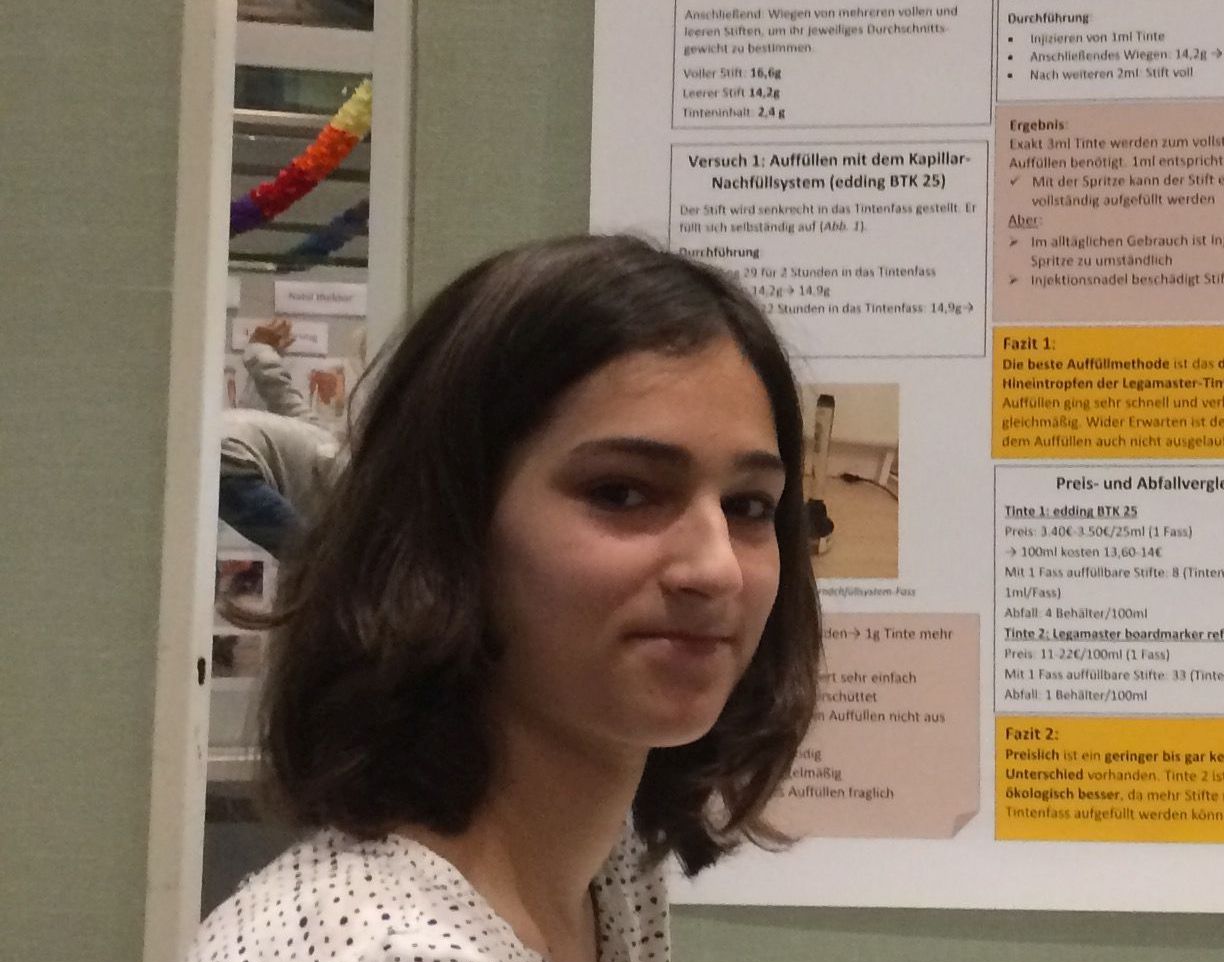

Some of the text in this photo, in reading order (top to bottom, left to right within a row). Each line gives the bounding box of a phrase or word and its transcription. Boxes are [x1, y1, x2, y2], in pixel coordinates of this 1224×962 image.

[683, 67, 716, 79] Voller
[682, 88, 717, 98] Leerer
[778, 108, 785, 118] g
[688, 153, 747, 168] Versuch
[842, 152, 866, 166] mit
[871, 152, 904, 166] dem
[909, 151, 970, 168] Kapillar-
[829, 174, 885, 191] (edding
[890, 174, 917, 187] BTK
[1032, 175, 1053, 188] Mit
[1057, 175, 1077, 187] der
[1082, 174, 1124, 188] Spritze
[1129, 174, 1159, 186] kann
[1163, 173, 1184, 186] der
[1188, 172, 1214, 185] Stift
[1031, 193, 1099, 208] vollständig
[1166, 192, 1215, 205] werden
[1007, 213, 1041, 229] Aber:
[1003, 336, 1038, 350] Fazit
[1002, 358, 1023, 370] Die
[1027, 357, 1063, 370] beste
[1173, 359, 1187, 369] ist
[1192, 357, 1214, 369] das
[1002, 376, 1093, 390] Hineintropfen
[1096, 376, 1118, 389] der
[1056, 476, 1098, 490] Preis-
[1103, 476, 1132, 490] und
[1005, 505, 1035, 519] Tinte
[1052, 505, 1094, 519] edding
[1097, 505, 1119, 518] BTK
[883, 627, 915, 639] Tinte
[919, 627, 952, 640] mehr
[1004, 627, 1035, 641] Tinte
[1053, 628, 1120, 642] Legamaster
[1125, 628, 1204, 642] boardmarker
[840, 671, 916, 684] sehr einfach
[1005, 726, 1040, 741] Fazit
[1005, 748, 1059, 760] Preislich
[1063, 750, 1076, 760] ist
[1081, 752, 1100, 760] ein
[1104, 749, 1158, 764] geringer
[1162, 750, 1180, 762] bis
[1184, 753, 1206, 765] gar
[1005, 767, 1083, 781] Unterschied
[1165, 769, 1196, 782] Tinte
